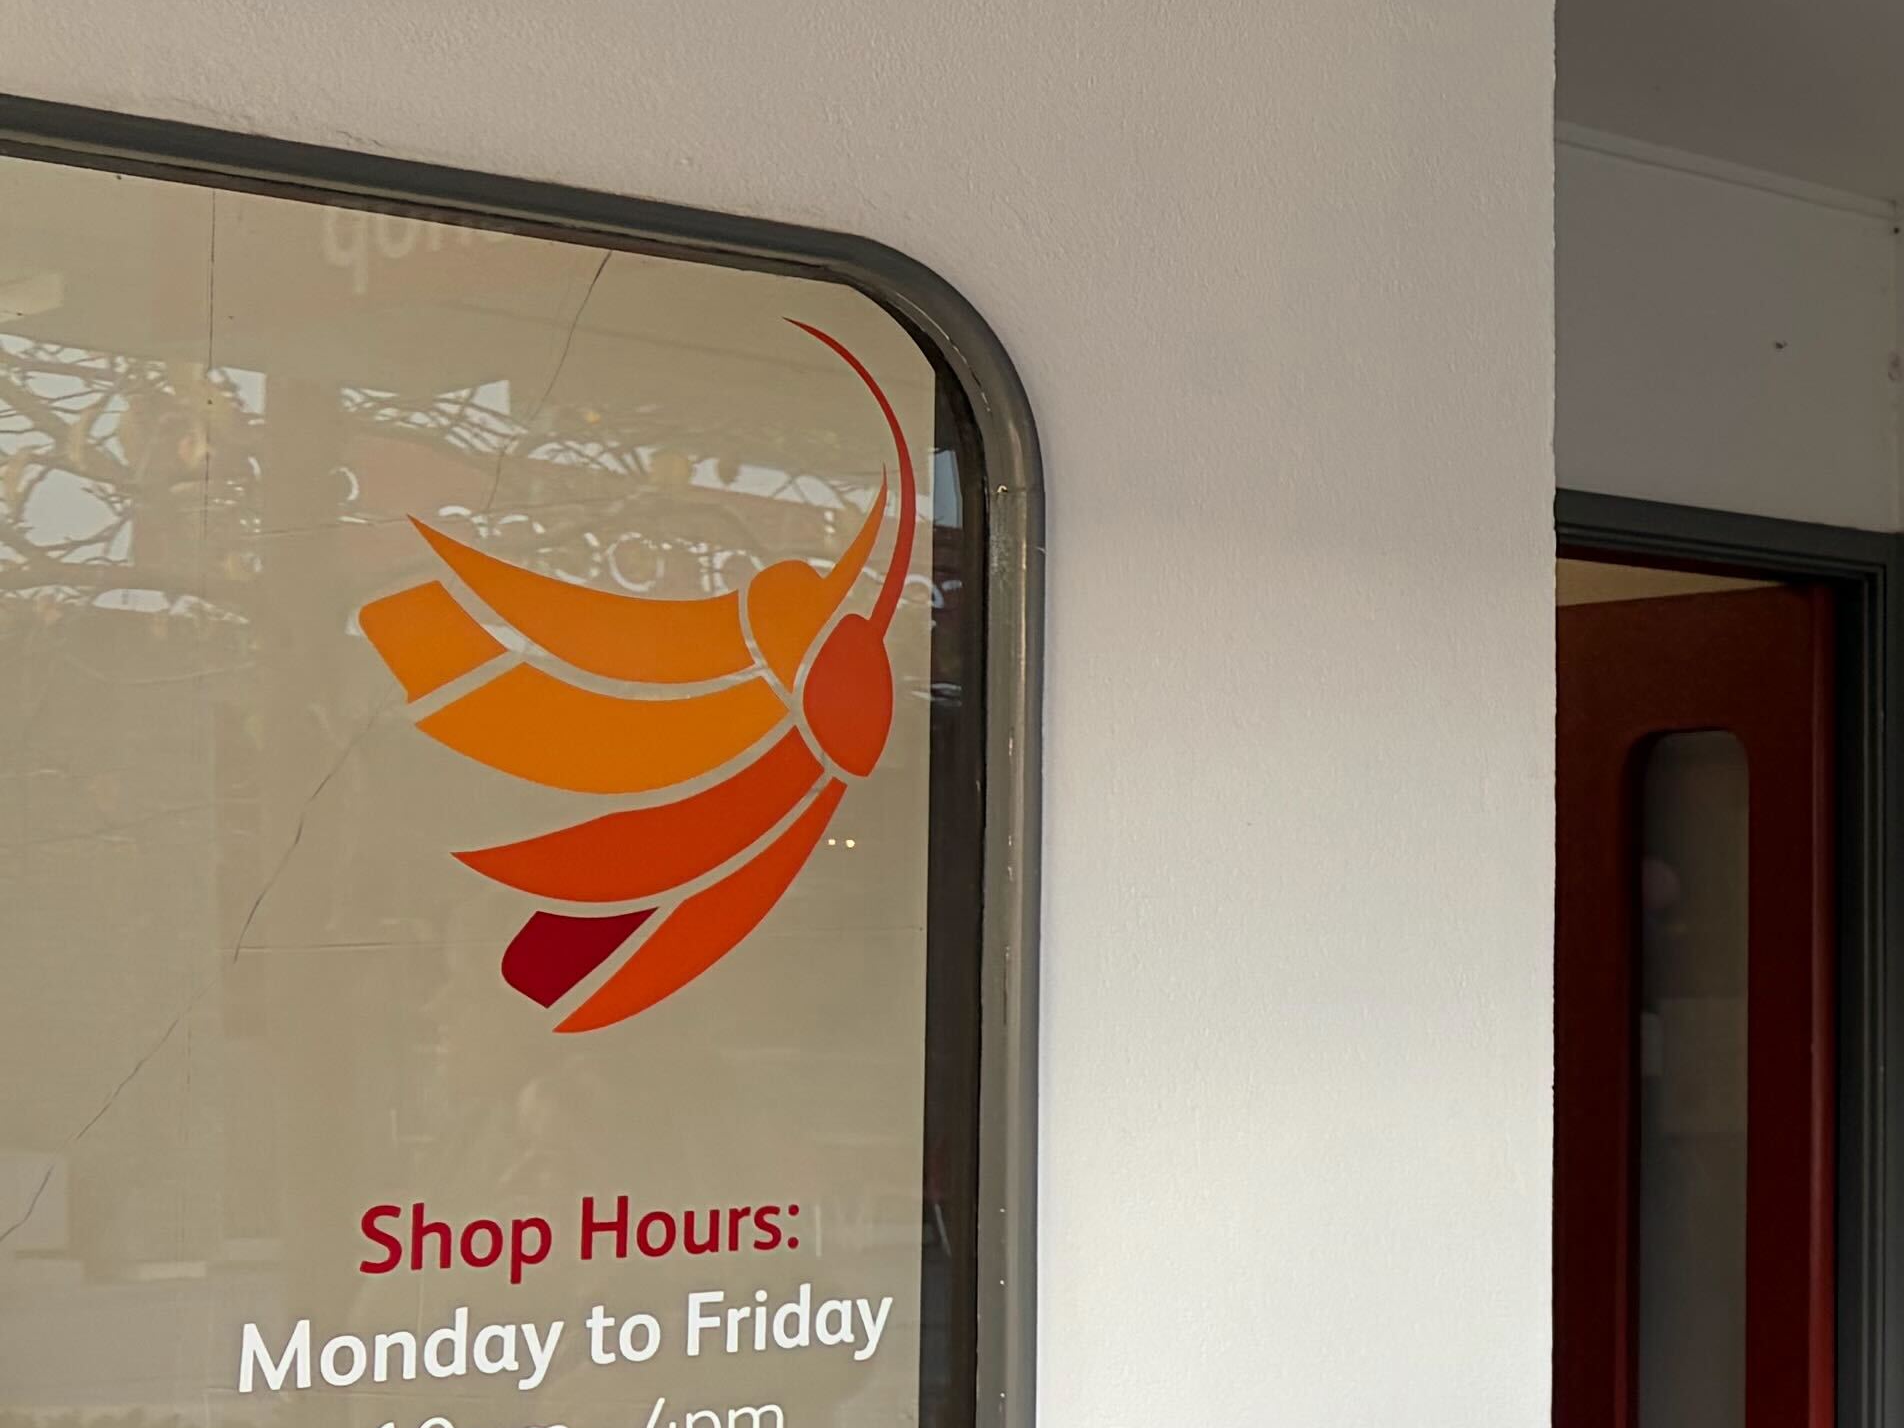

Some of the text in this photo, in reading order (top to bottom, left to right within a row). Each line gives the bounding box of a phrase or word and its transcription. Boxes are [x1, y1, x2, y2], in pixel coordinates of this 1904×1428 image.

[359, 1195, 802, 1284] Shop Hours:
[239, 1283, 893, 1393] Monday to Friday
